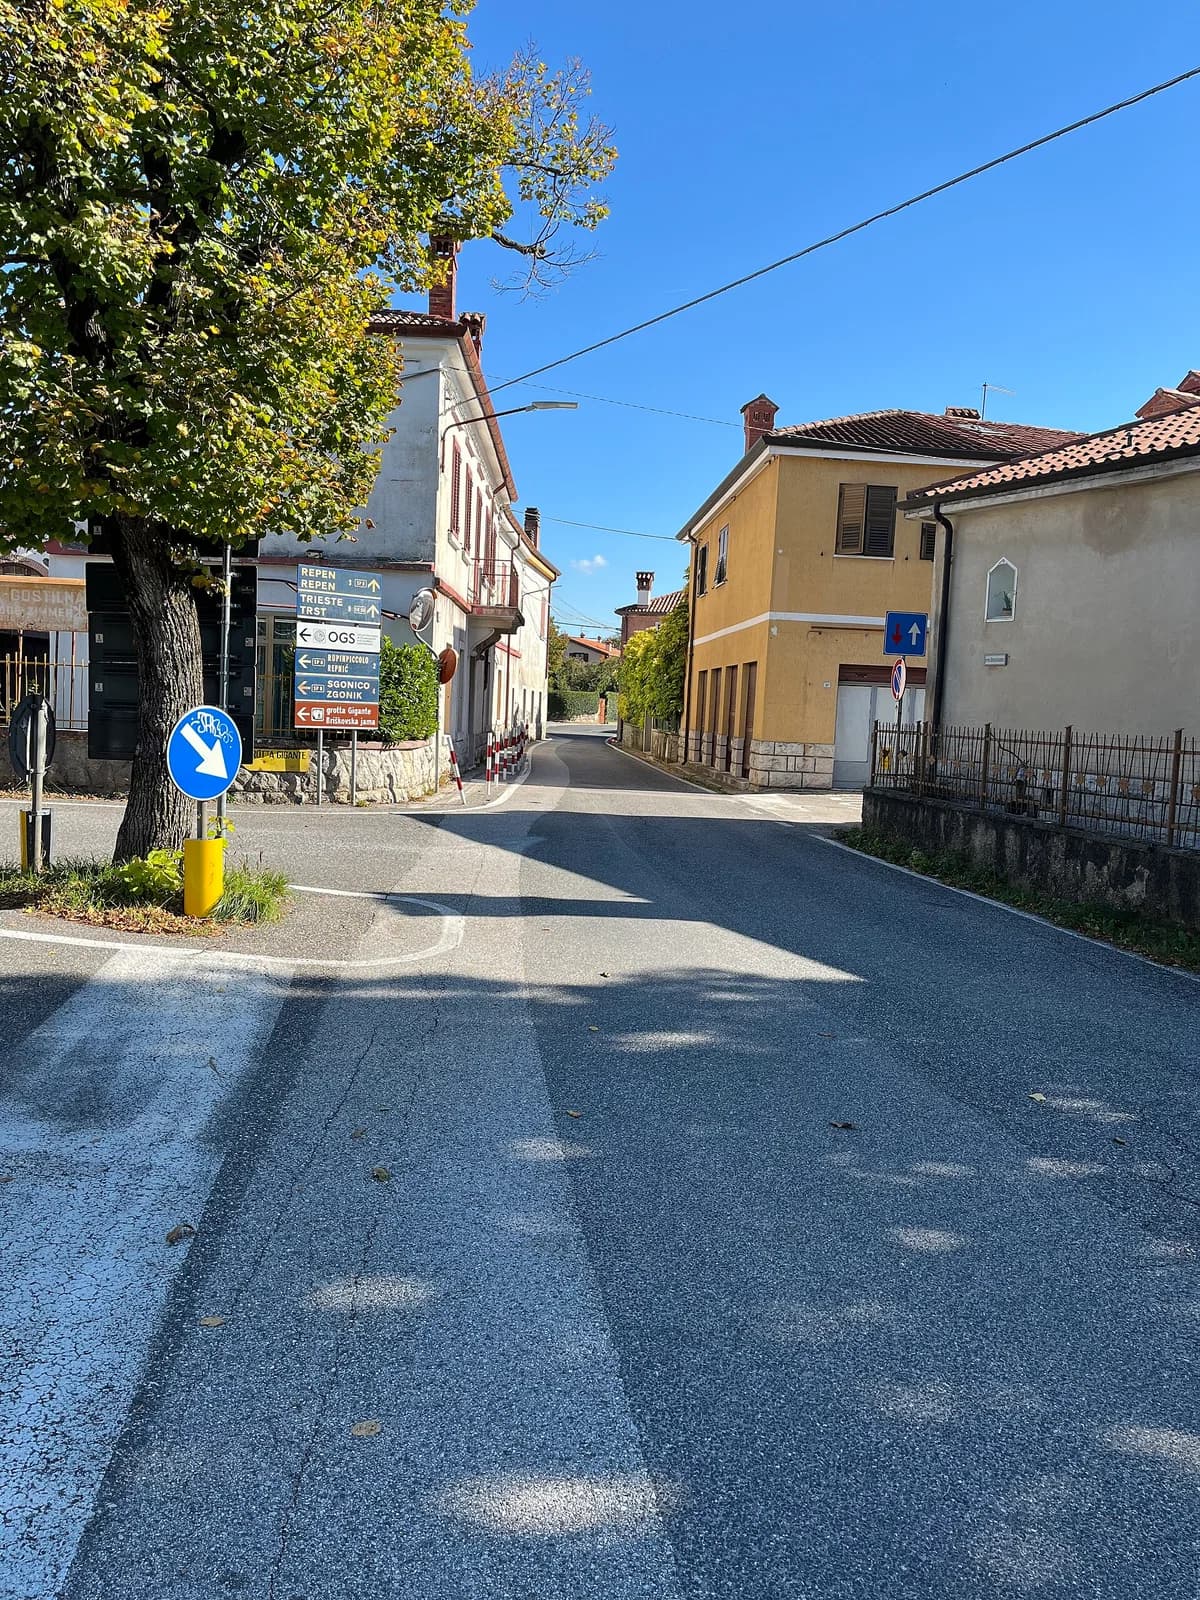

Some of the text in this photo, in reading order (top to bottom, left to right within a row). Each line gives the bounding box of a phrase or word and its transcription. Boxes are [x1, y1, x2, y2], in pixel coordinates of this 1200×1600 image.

[301, 567, 336, 580] REPEN
[301, 579, 336, 591] REPEN
[300, 594, 344, 607] TRIESTE
[300, 605, 327, 616] TRST
[328, 631, 356, 644] OGS
[327, 680, 370, 690] SGONICO
[326, 690, 363, 700] ZGONIK
[326, 706, 346, 716] grotta
[360, 718, 376, 727] jama
[276, 750, 307, 760] GIGANTE
